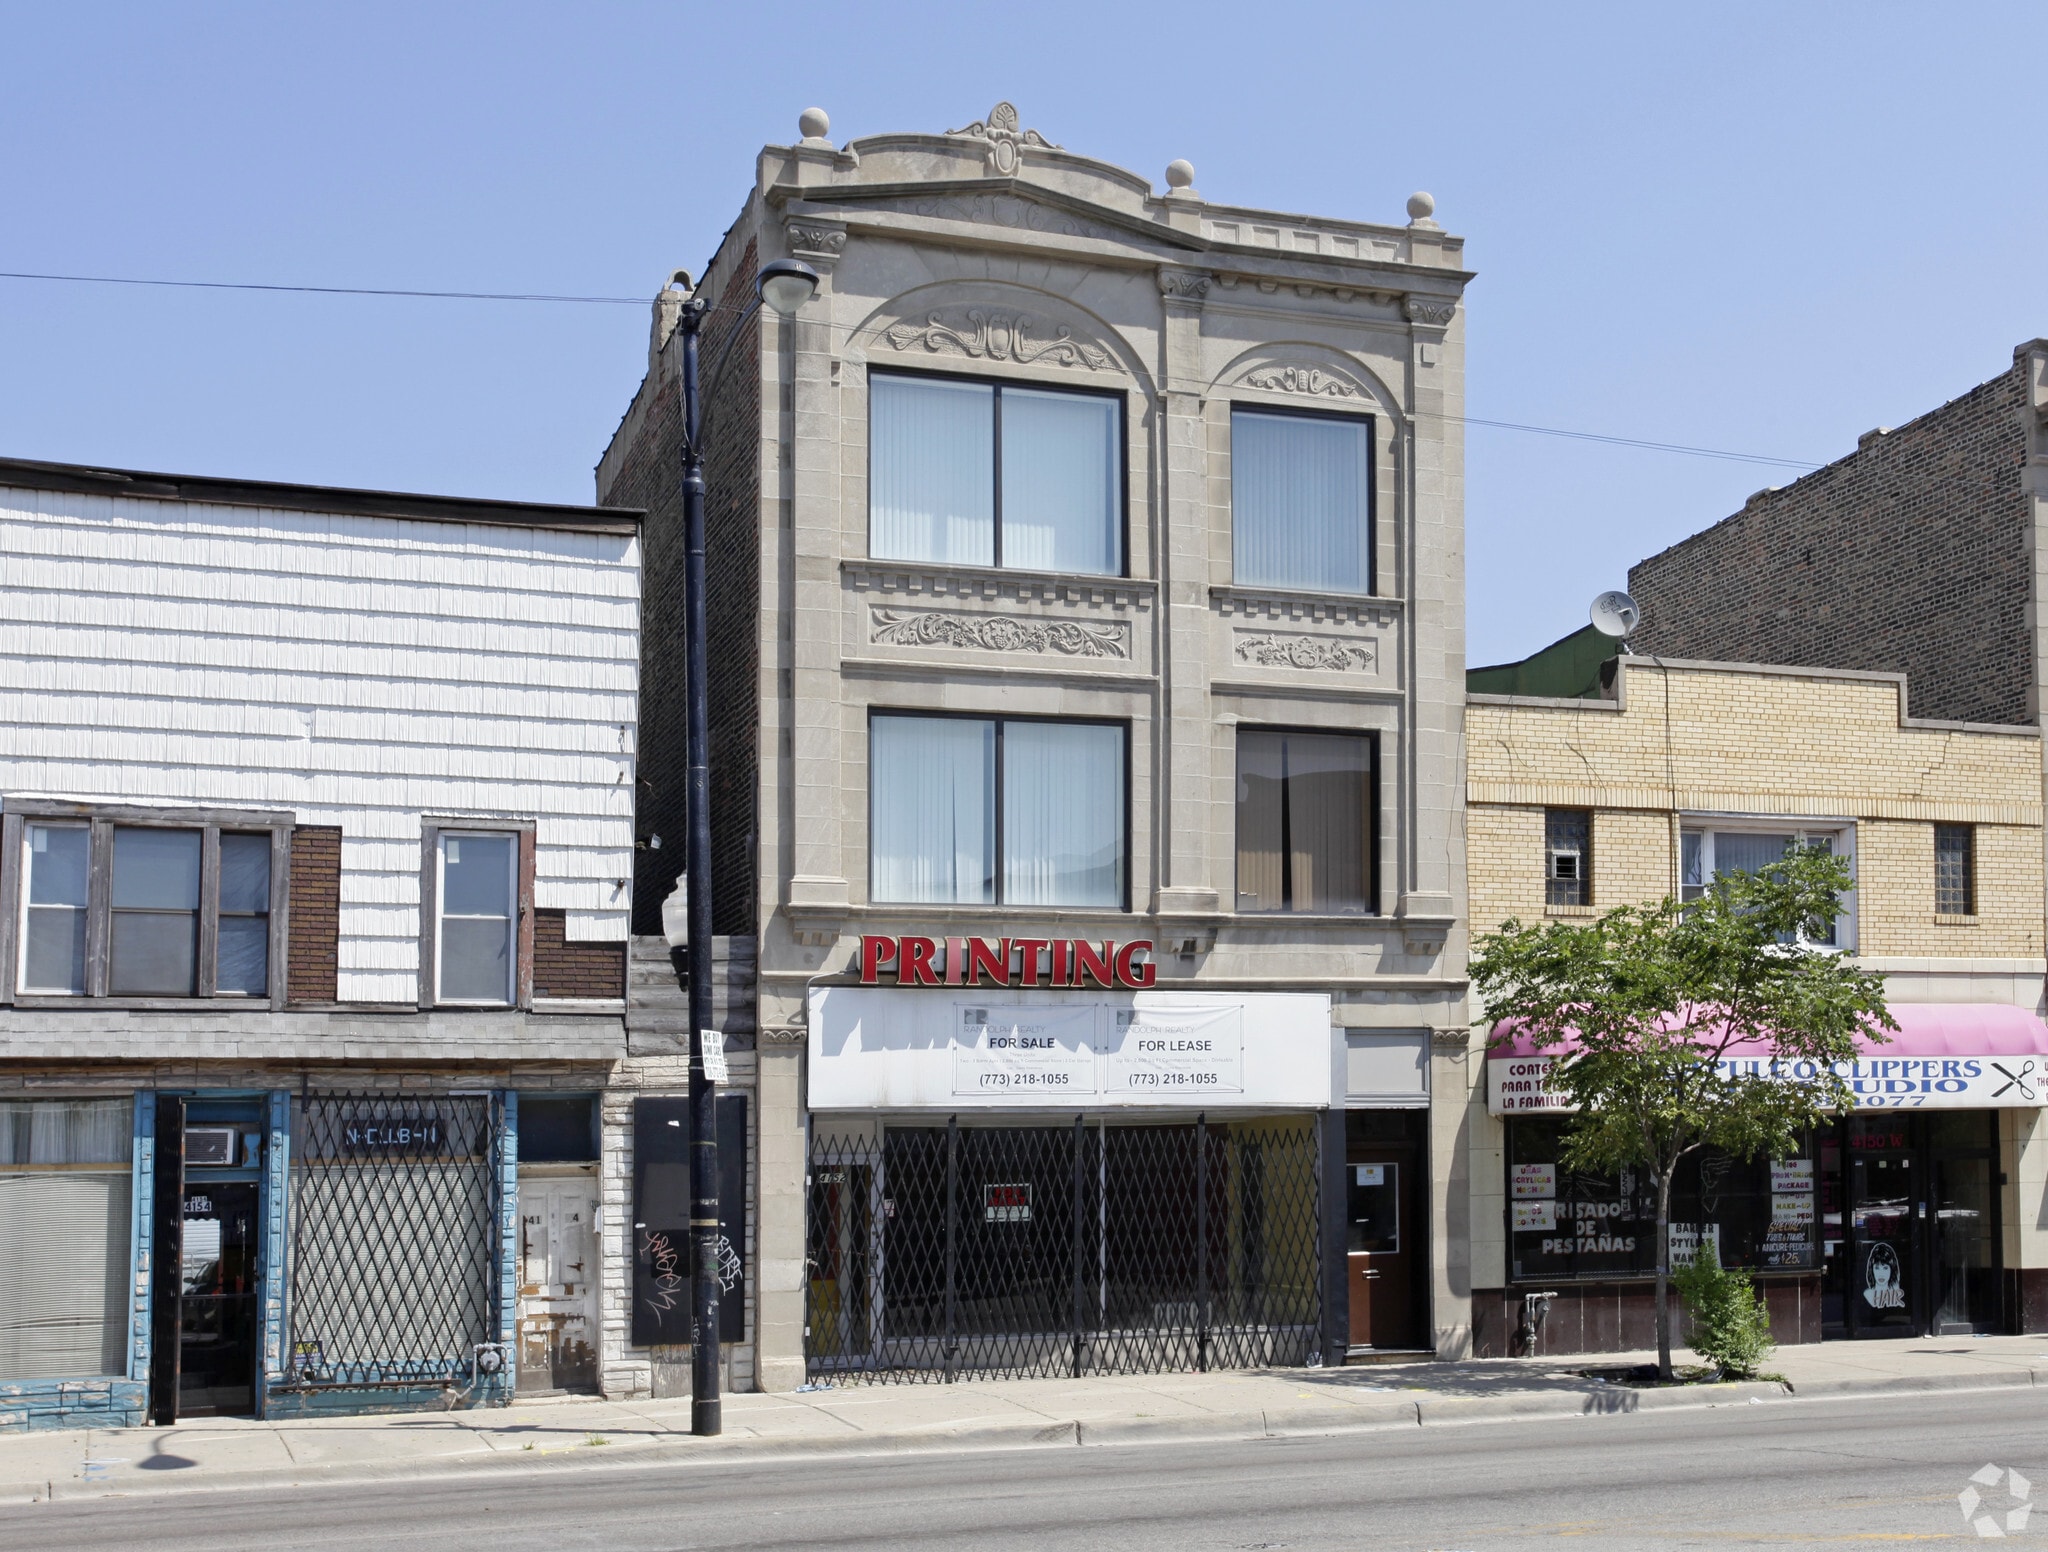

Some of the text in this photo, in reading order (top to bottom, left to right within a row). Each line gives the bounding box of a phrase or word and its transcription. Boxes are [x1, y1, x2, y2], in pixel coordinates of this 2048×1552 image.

[859, 934, 1157, 988] PRINTING
[990, 1037, 1055, 1048] FOR SALE
[1138, 1040, 1212, 1051] FOR LEASE
[1828, 1060, 1983, 1078] CLIPPERS
[979, 1073, 1069, 1087] (773) 218-1055
[1129, 1073, 1218, 1087] (773) 218-1055
[1502, 1081, 1532, 1093] PARA
[1503, 1096, 1568, 1108] LA FAMILIA
[1852, 1134, 1886, 1148] 4150
[1890, 1133, 1904, 1147] W
[1778, 1182, 1810, 1190] PACKAGE
[185, 1201, 212, 1212] 4154
[1555, 1202, 1621, 1219] RISADO
[1576, 1221, 1597, 1236] DE
[1676, 1223, 1714, 1233] BARER
[1542, 1233, 1636, 1255] PESTAÑAS
[1873, 1288, 1905, 1308] HAIR
